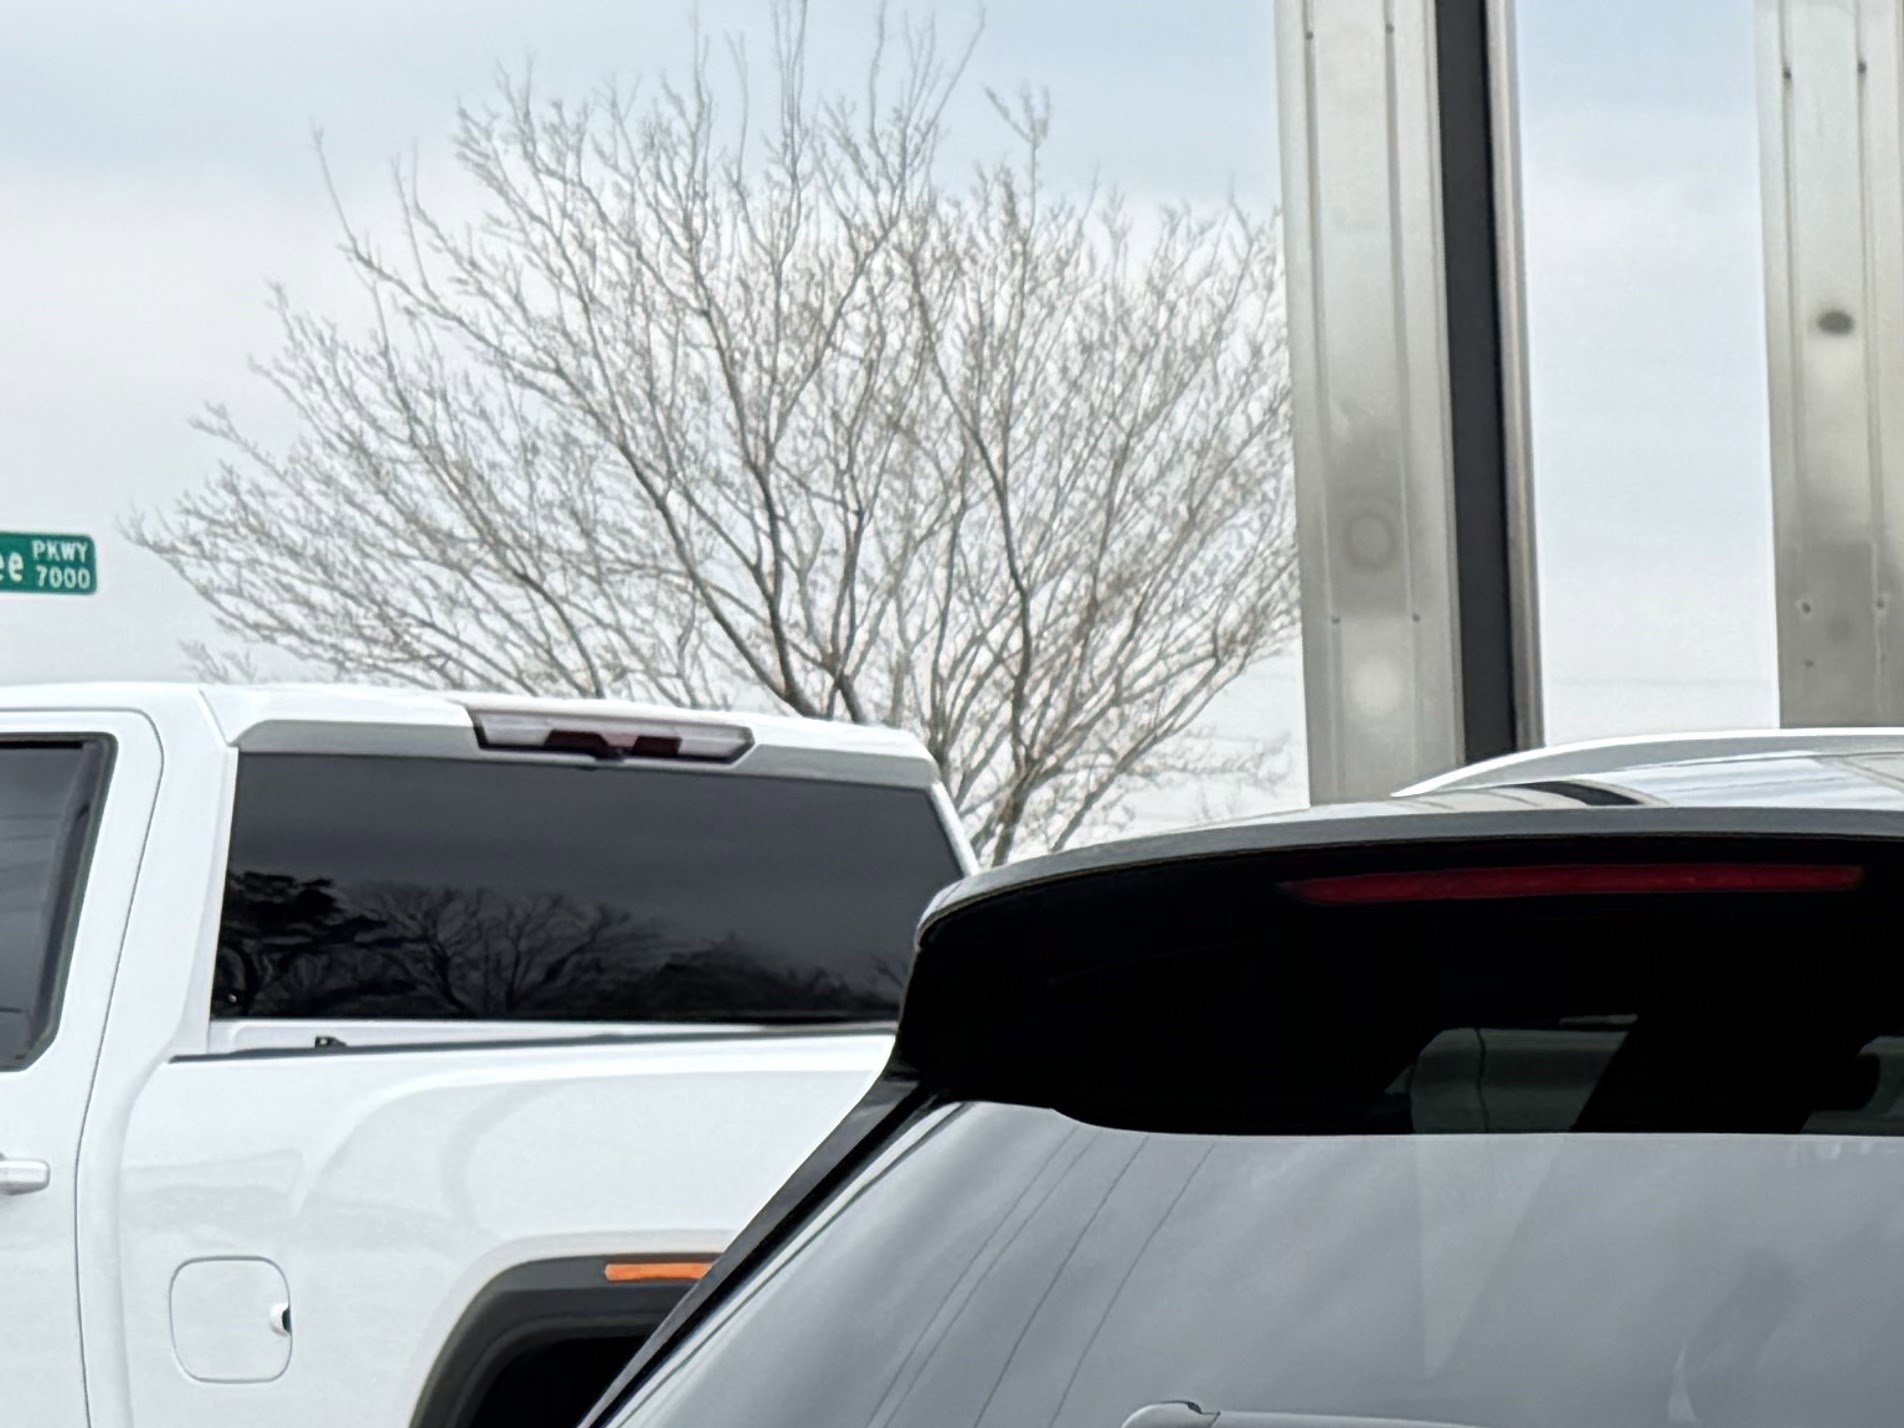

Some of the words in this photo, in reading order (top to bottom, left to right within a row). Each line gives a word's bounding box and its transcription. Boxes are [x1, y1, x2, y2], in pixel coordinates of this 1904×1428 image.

[0, 551, 24, 582] e
[31, 539, 88, 563] PKWY
[36, 564, 91, 589] 7000
